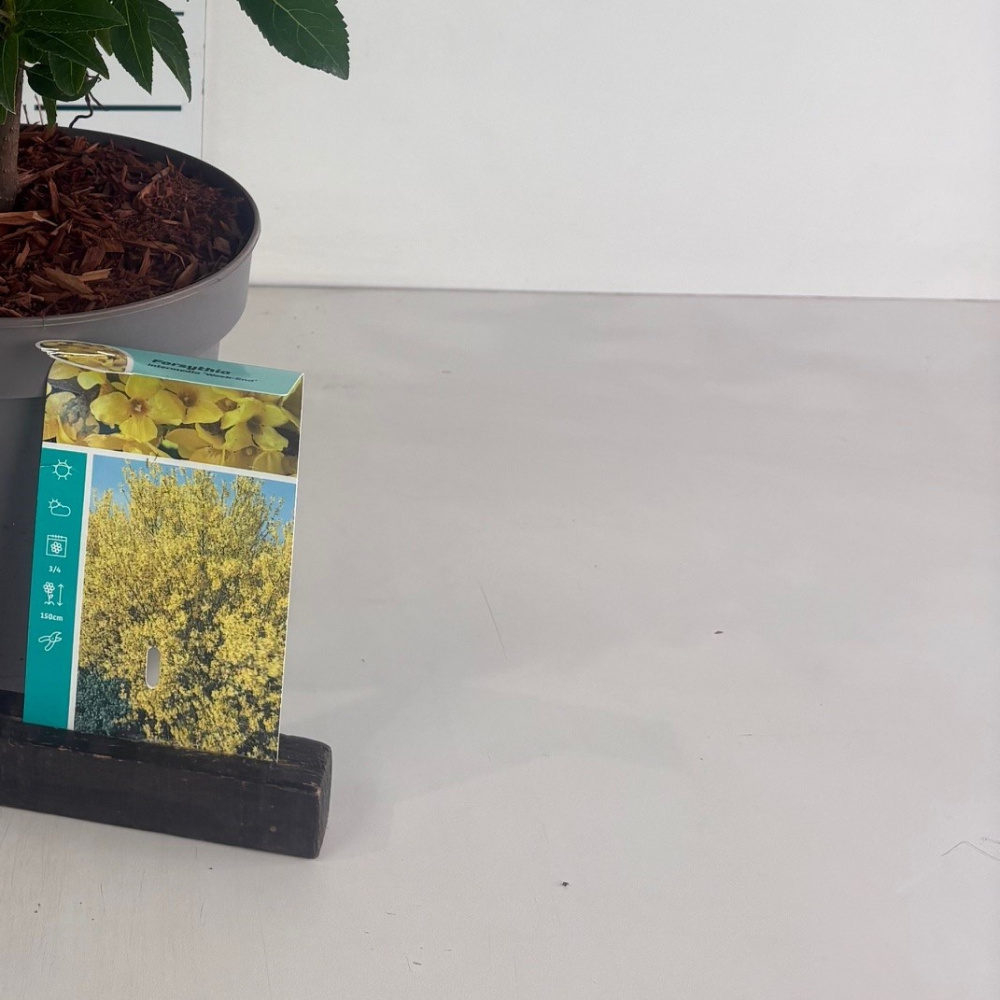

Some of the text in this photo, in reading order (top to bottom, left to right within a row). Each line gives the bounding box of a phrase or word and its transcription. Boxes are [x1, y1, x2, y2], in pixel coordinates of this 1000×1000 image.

[152, 359, 231, 375] Forsythia
[49, 565, 62, 573] 3/4
[40, 612, 64, 622] 150cm
